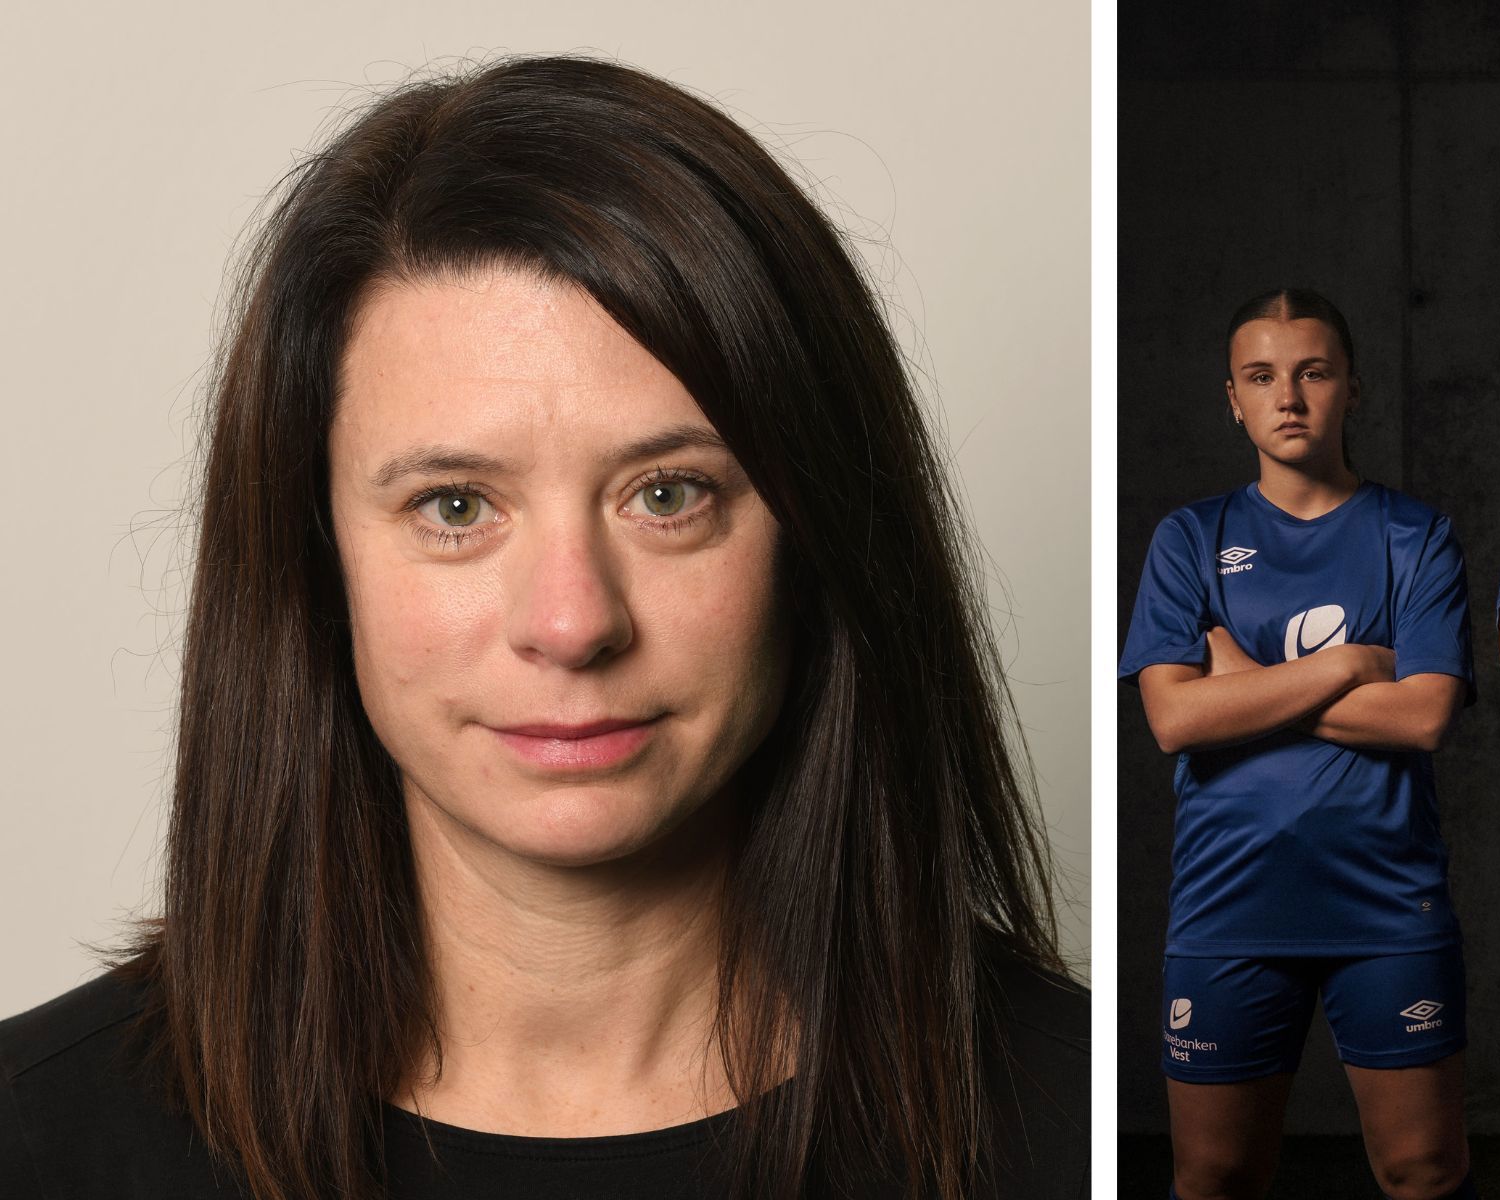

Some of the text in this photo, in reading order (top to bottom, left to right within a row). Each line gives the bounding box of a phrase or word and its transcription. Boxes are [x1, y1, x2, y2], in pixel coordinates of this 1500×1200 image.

[1217, 563, 1253, 575] umbro
[1405, 1019, 1443, 1033] umbro
[1170, 1045, 1191, 1062] Vest
